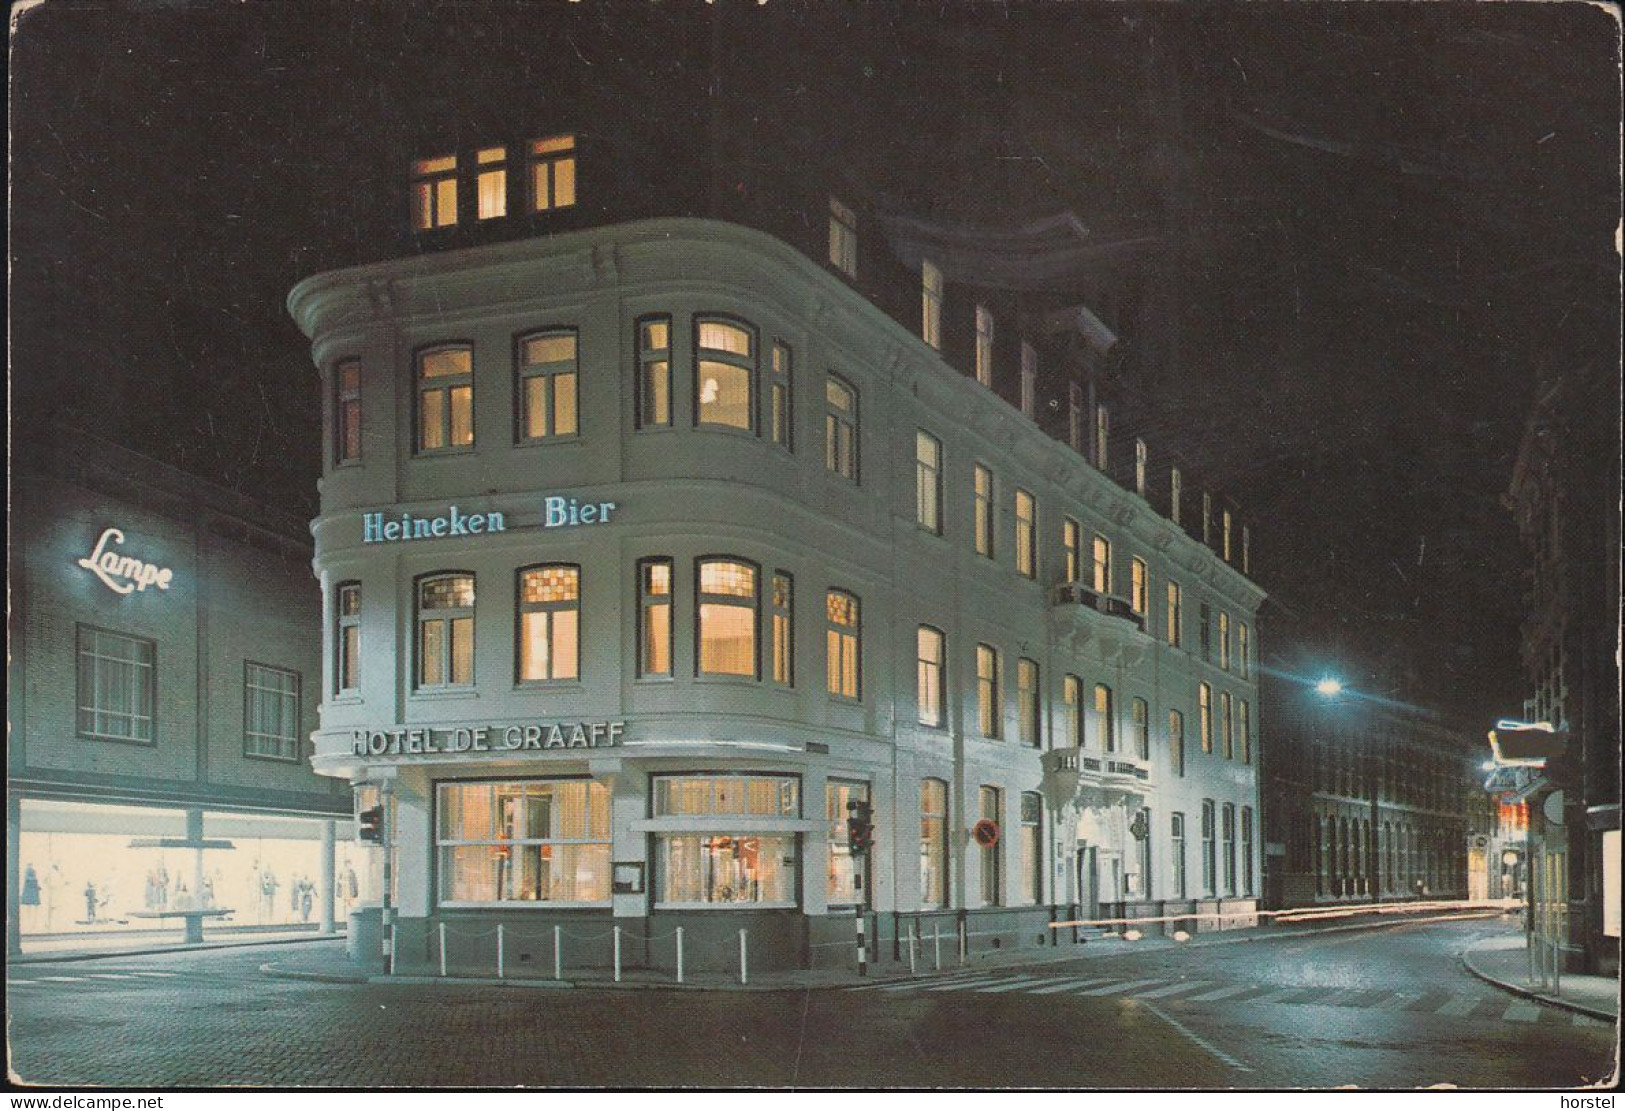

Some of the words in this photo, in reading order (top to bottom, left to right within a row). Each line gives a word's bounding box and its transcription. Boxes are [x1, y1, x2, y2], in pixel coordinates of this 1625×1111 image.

[363, 505, 506, 543] Heineken
[545, 496, 616, 528] Bier
[78, 528, 173, 594] Lampe
[351, 728, 439, 755] HOTEL
[453, 726, 491, 752] DE
[504, 720, 625, 750] GRAAFF
